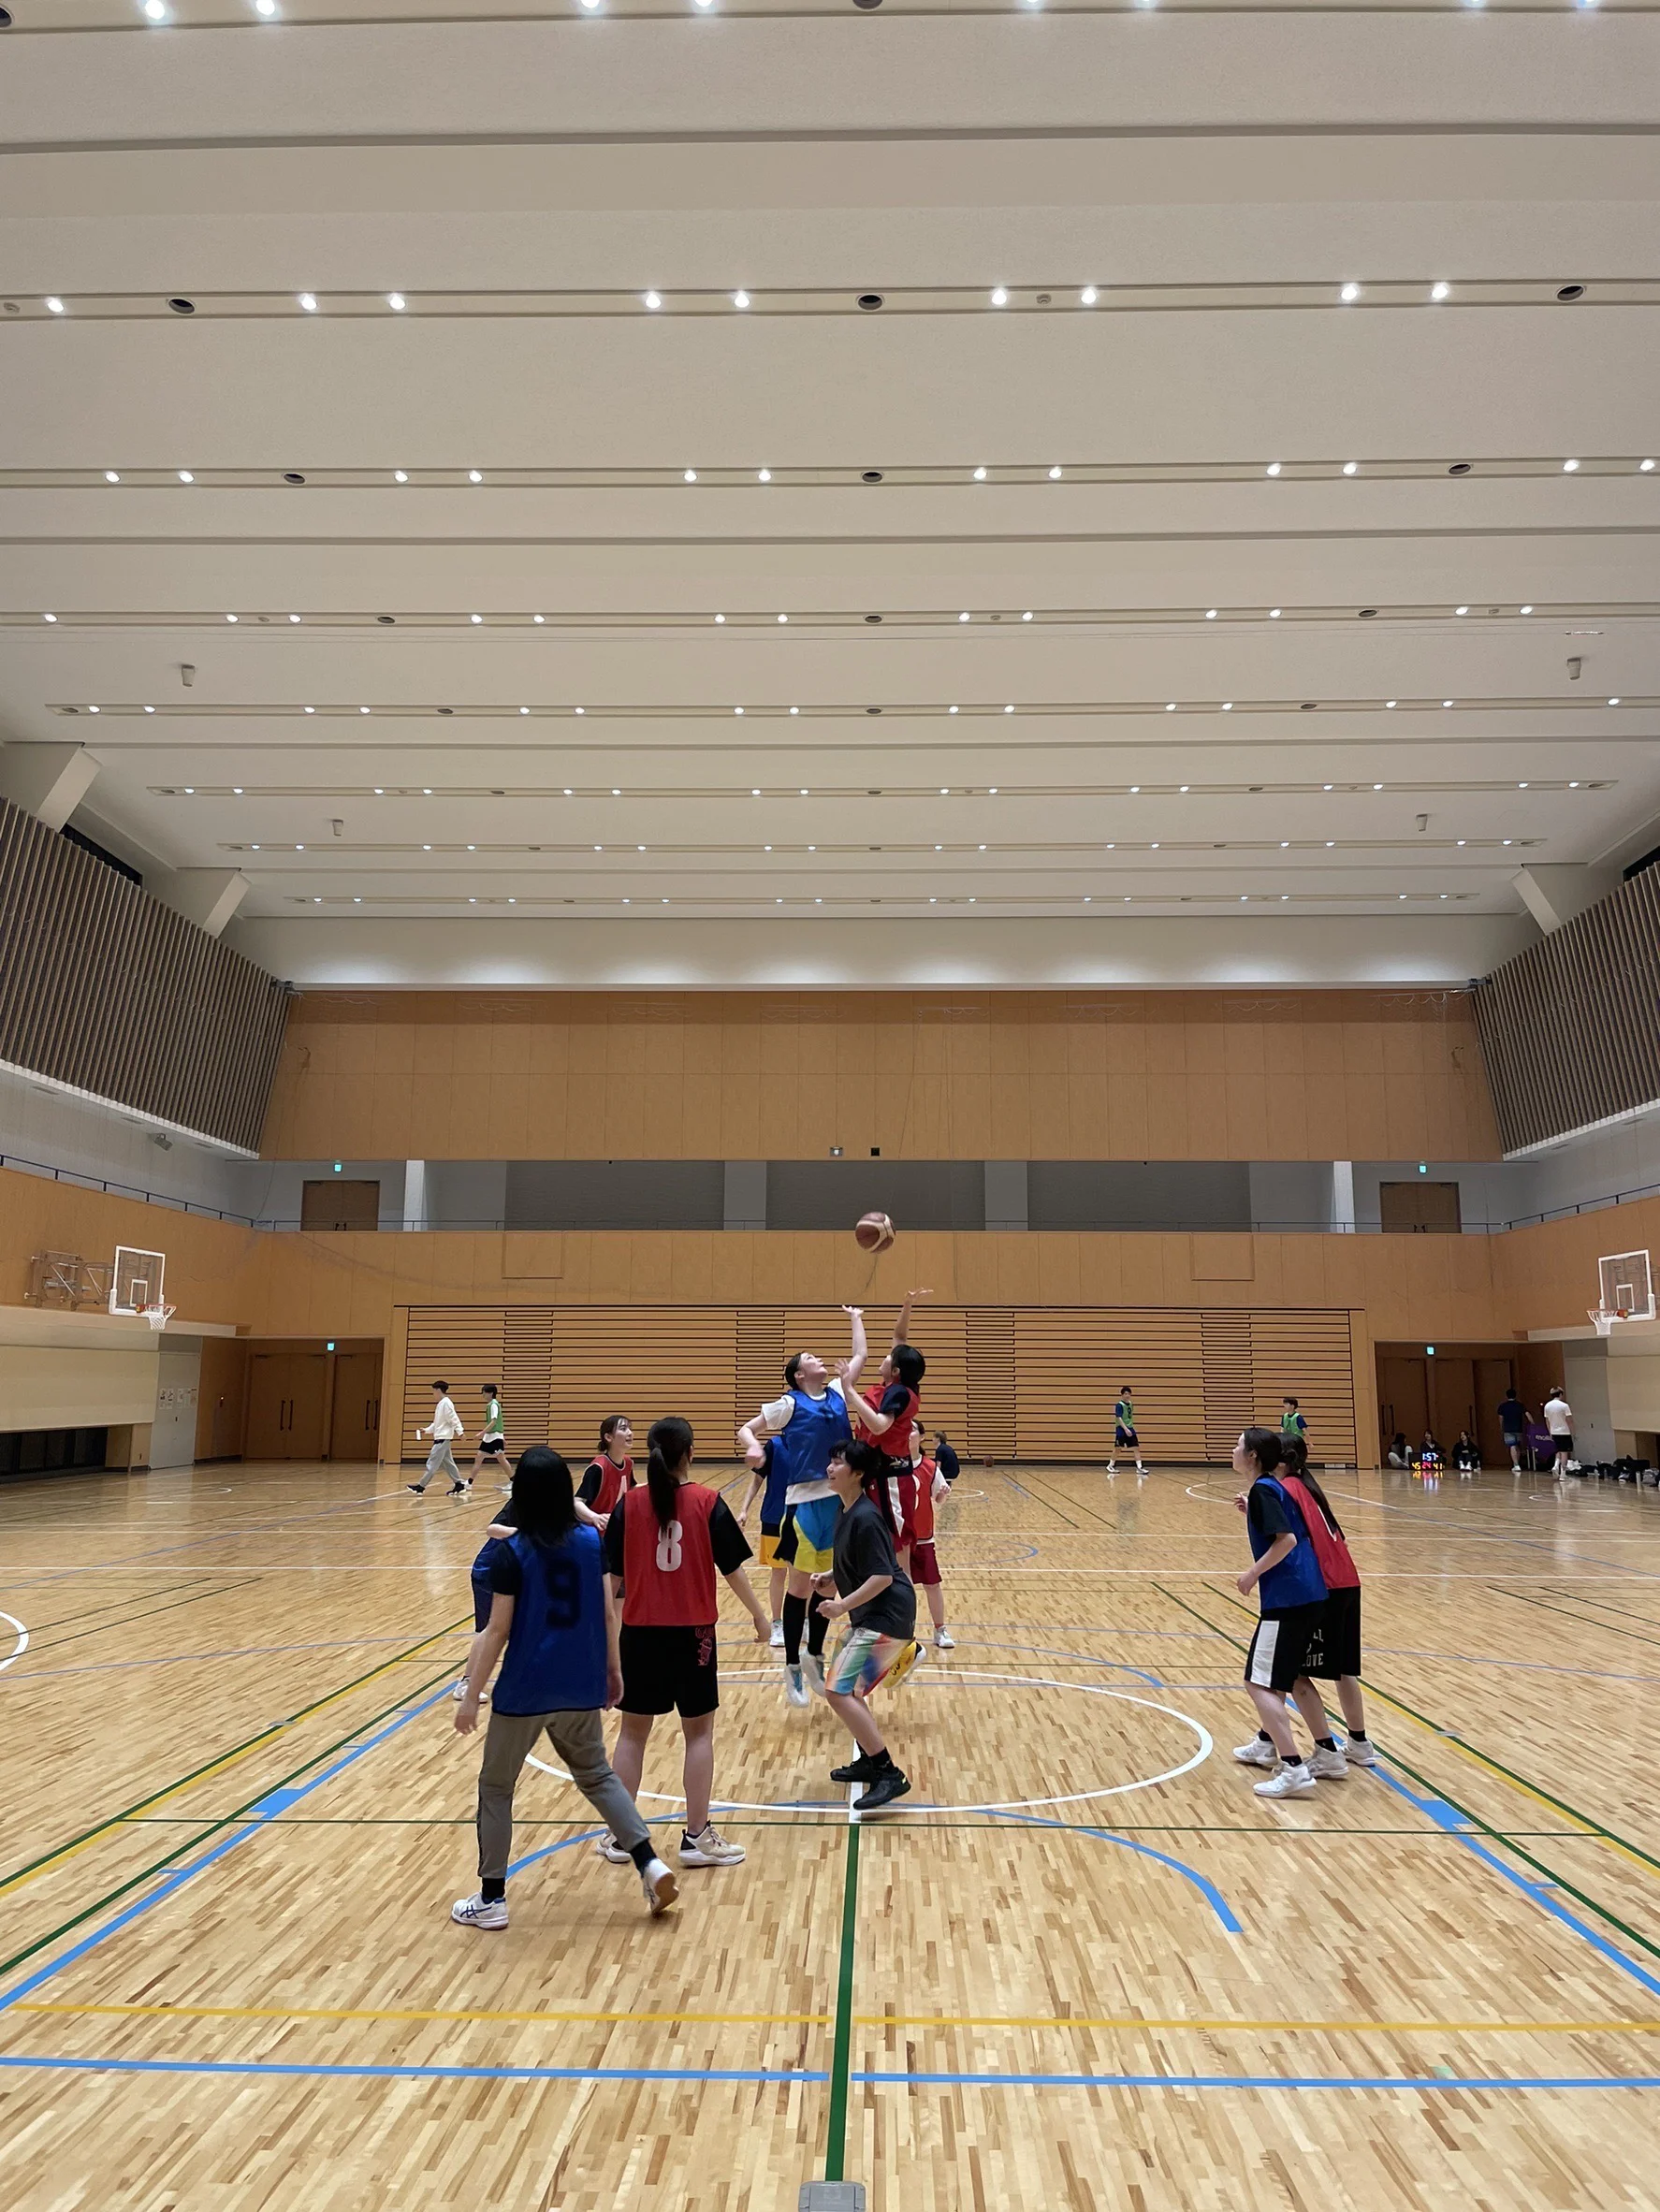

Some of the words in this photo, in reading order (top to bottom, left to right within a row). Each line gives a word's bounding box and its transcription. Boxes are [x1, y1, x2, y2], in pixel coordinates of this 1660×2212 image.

[1412, 1462, 1421, 1470] 45
[656, 1520, 683, 1572] 8
[546, 1560, 581, 1629] 9
